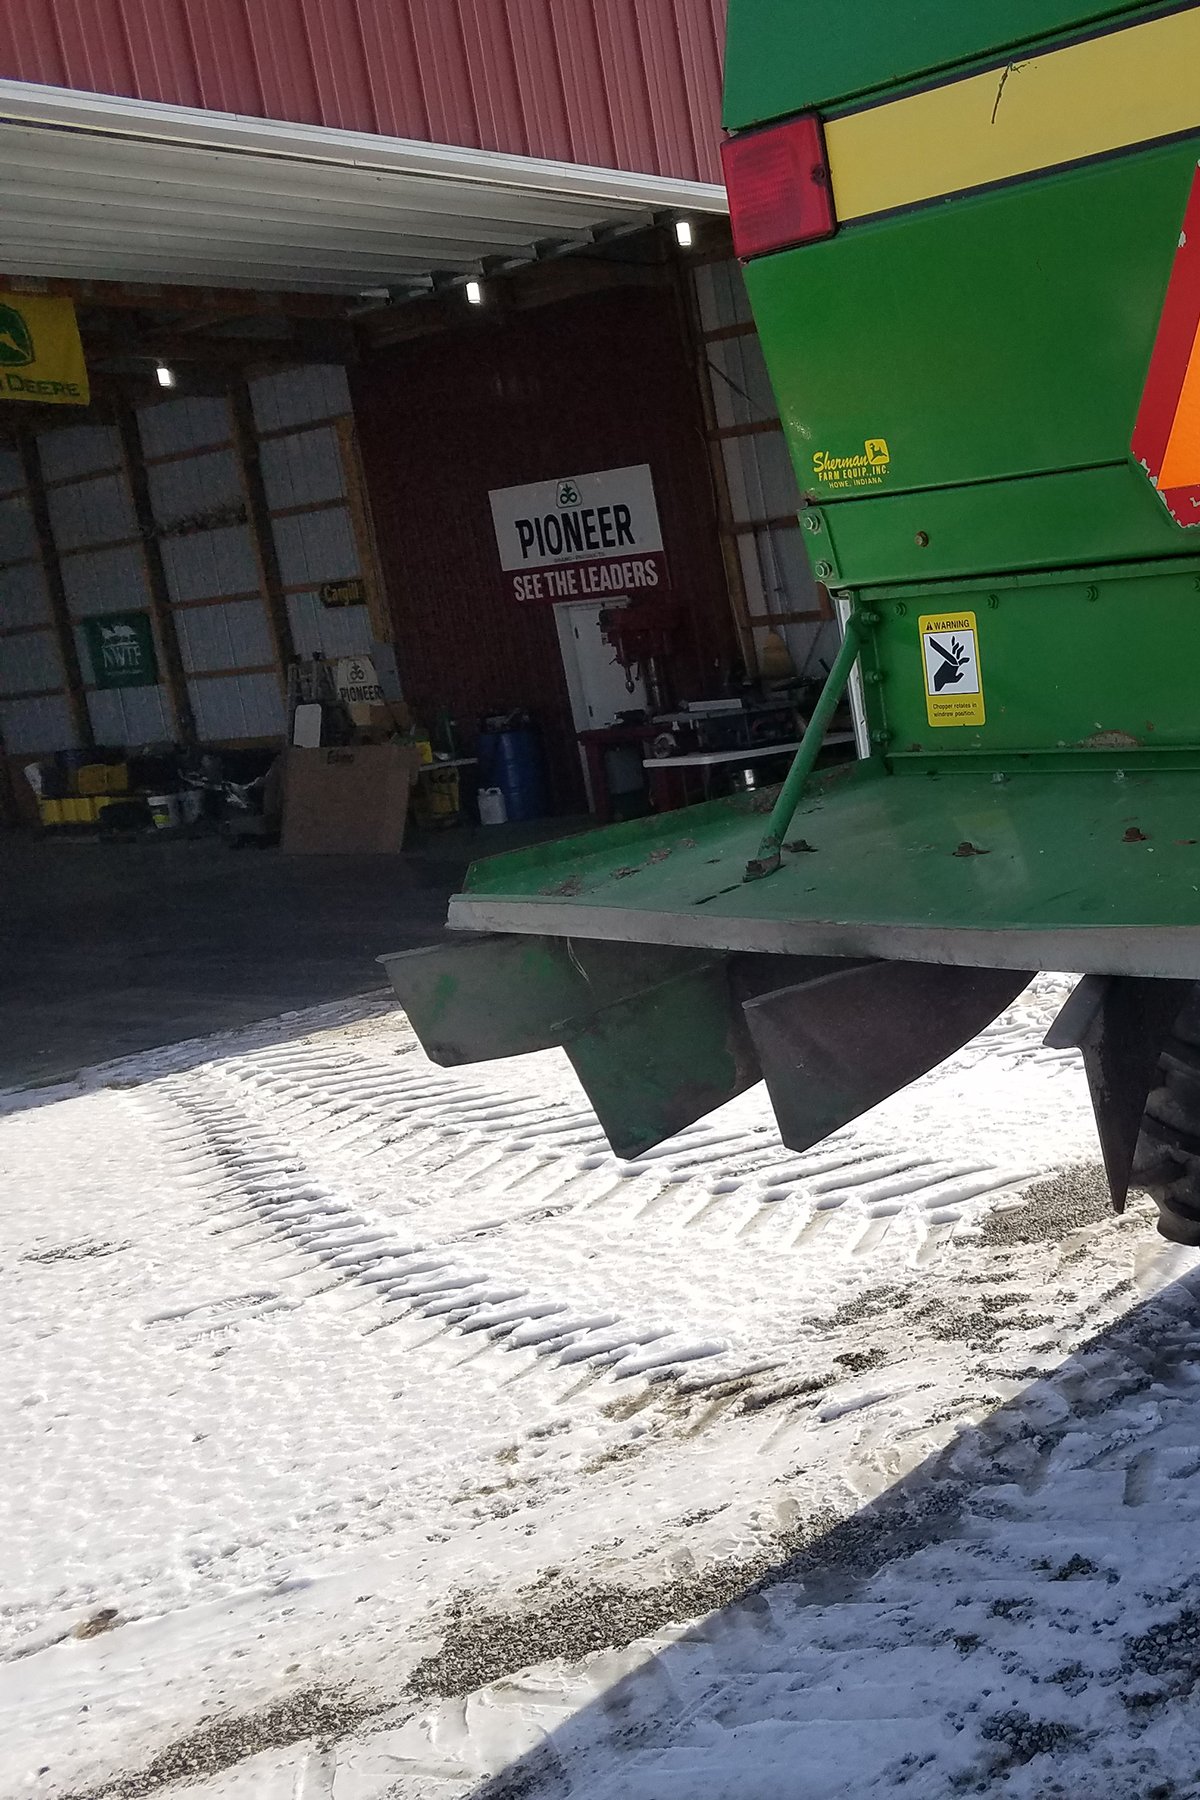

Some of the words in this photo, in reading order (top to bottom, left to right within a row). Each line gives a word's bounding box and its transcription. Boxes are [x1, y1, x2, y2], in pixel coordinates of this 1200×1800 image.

[5, 373, 81, 396] DEERE
[813, 451, 869, 472] Sherman
[819, 470, 840, 481] FARM
[854, 477, 882, 486] INDIANA
[515, 504, 635, 558] PIONEER
[513, 574, 543, 601] SEE
[544, 569, 577, 597] THE
[580, 559, 658, 593] LEADERS
[934, 619, 970, 630] WARNING
[339, 685, 384, 702] PIONEER
